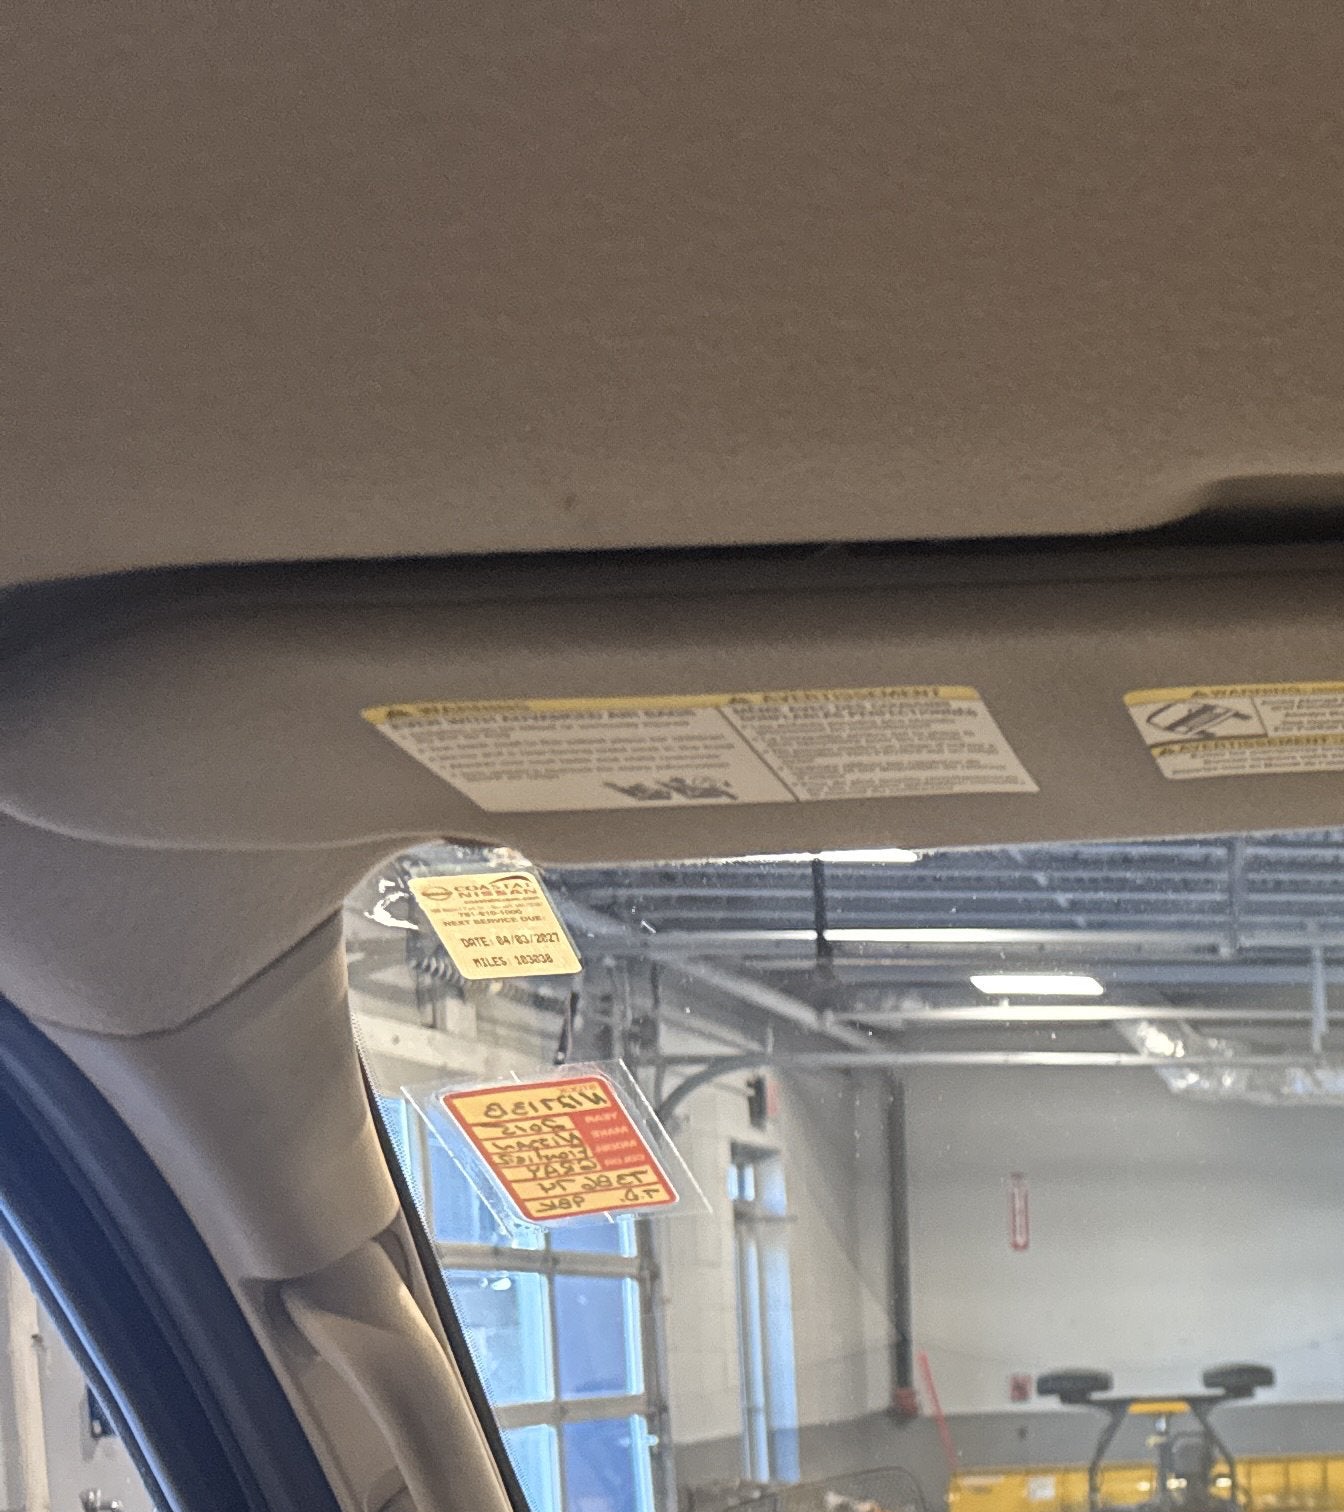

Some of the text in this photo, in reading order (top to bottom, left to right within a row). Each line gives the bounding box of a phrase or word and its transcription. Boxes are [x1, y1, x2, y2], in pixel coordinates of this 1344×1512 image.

[457, 888, 538, 899] NISSAN
[443, 919, 471, 927] NEXT
[473, 917, 519, 925] SERVICE
[460, 936, 494, 949] DATE:
